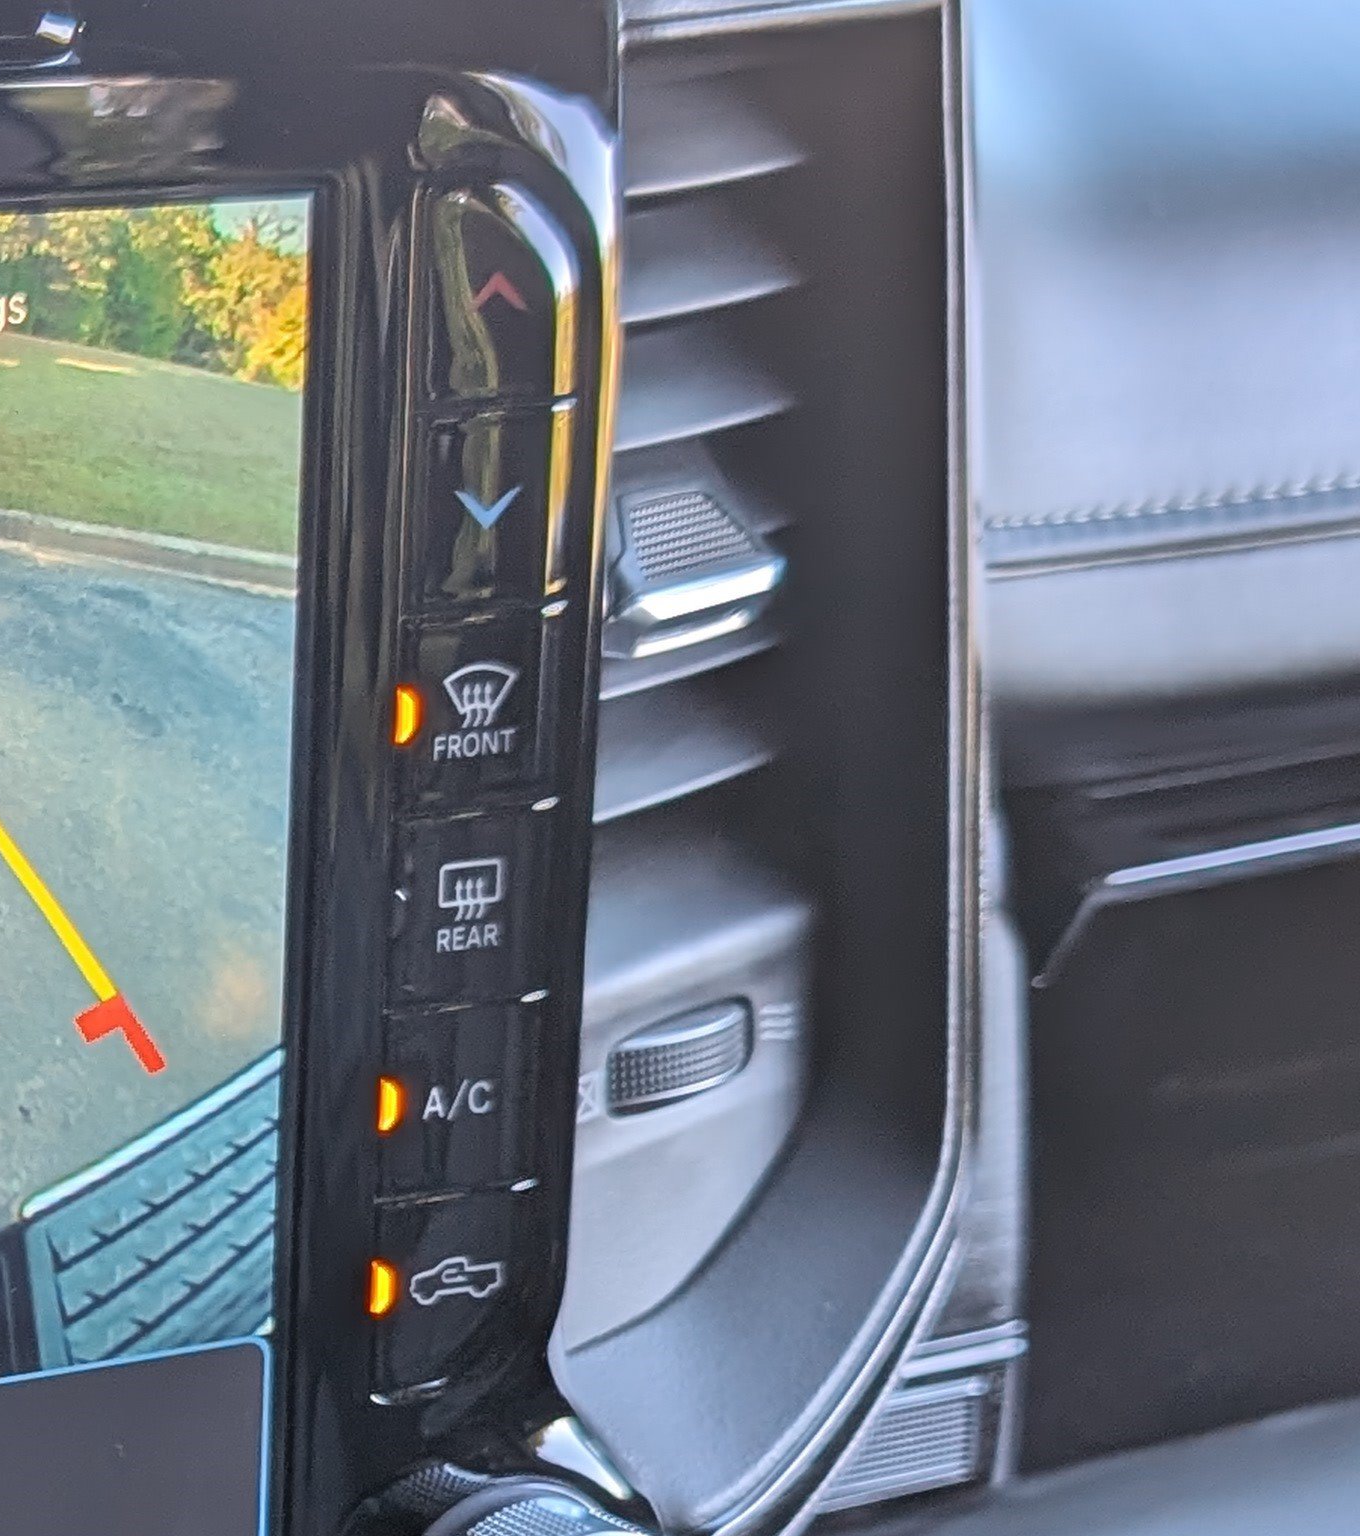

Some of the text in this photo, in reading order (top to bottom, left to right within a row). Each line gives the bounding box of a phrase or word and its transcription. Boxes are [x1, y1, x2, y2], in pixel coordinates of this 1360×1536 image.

[432, 728, 516, 761] FRONT
[436, 923, 499, 953] REAR
[422, 1079, 493, 1120] A/C
